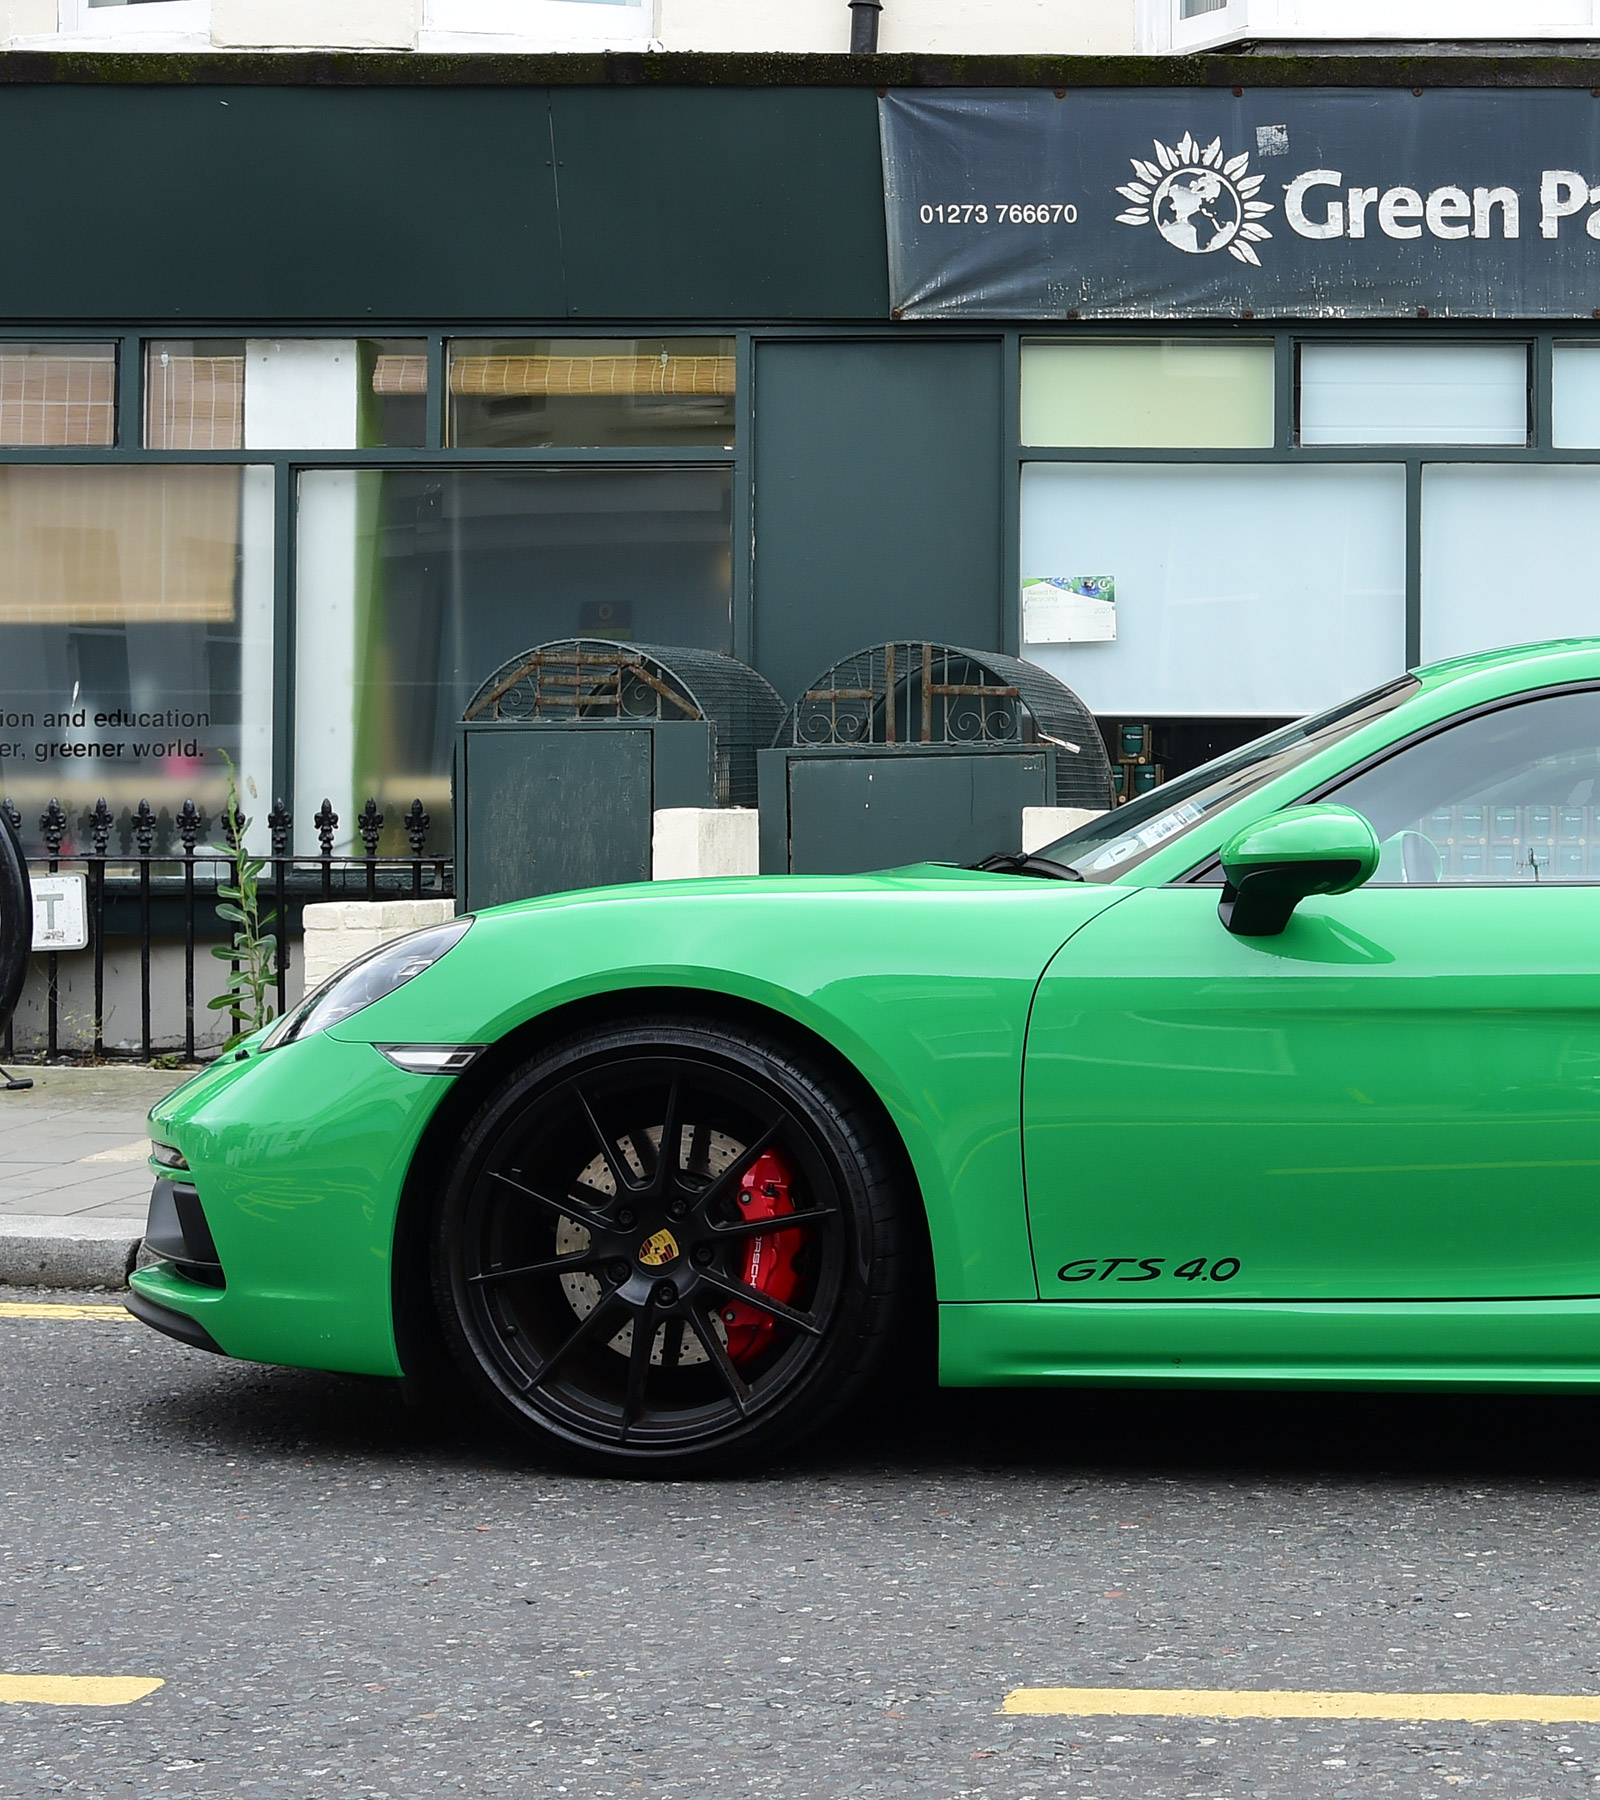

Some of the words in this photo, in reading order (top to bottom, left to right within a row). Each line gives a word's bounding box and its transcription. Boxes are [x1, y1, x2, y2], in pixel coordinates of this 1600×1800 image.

[919, 204, 988, 224] 01273
[998, 204, 1078, 224] 766670
[1283, 168, 1519, 240] Green
[0, 709, 35, 728] ion
[43, 709, 86, 728] and
[94, 709, 210, 728] education
[35, 742, 125, 762] greener
[133, 739, 204, 757] world.
[749, 1236, 762, 1289] RSCH
[1057, 1258, 1166, 1282] GTS
[1173, 1257, 1241, 1282] 4.0
